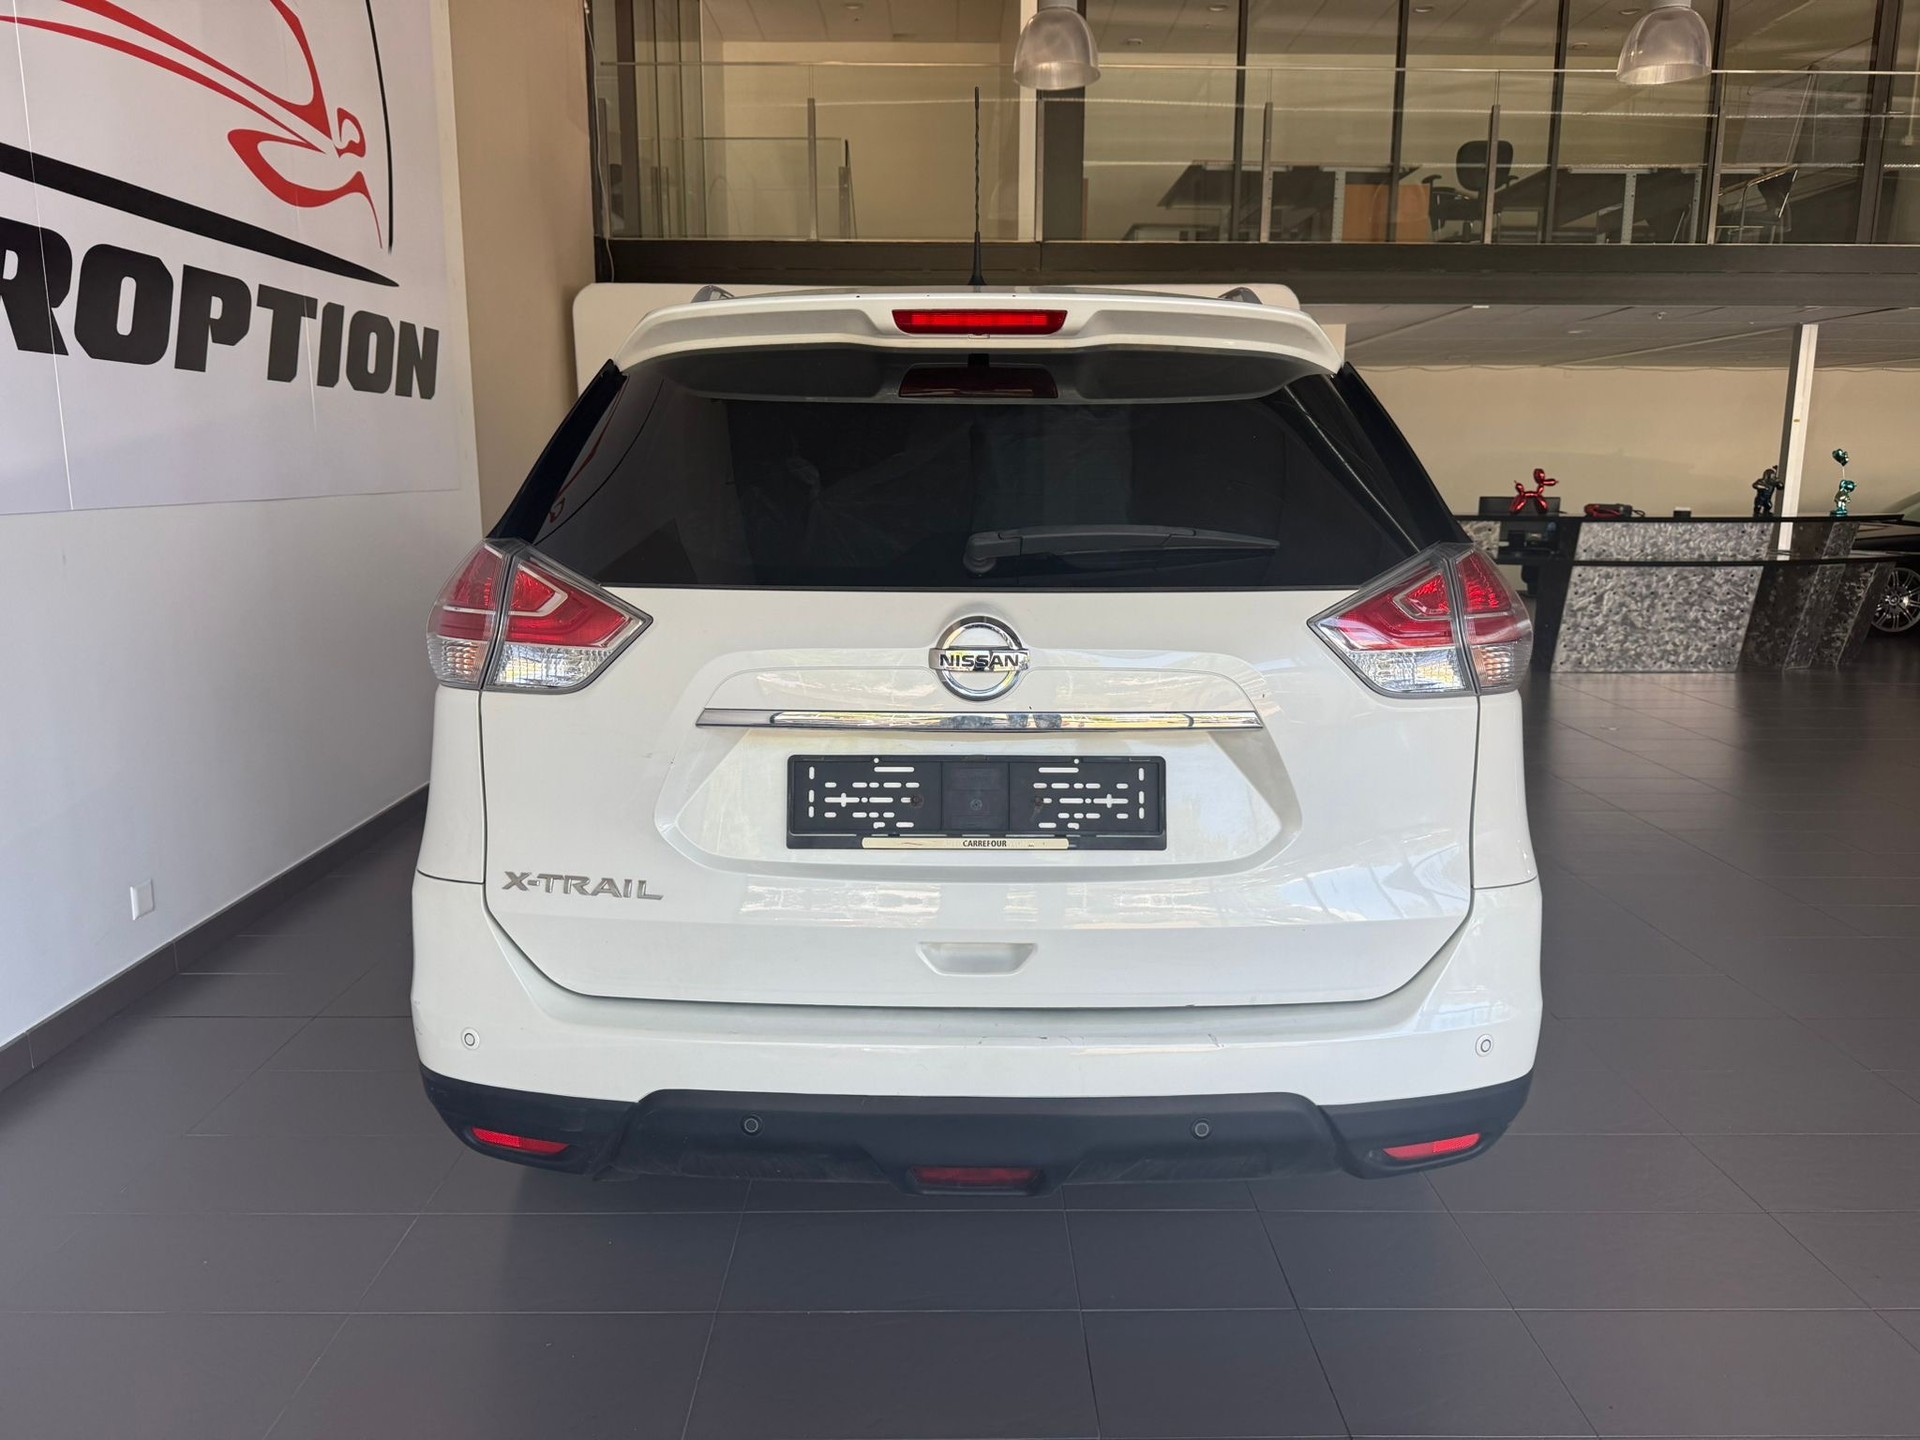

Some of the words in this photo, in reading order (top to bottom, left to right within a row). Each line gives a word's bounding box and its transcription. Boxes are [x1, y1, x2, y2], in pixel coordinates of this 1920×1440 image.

[940, 654, 1018, 668] NISSAN
[963, 840, 1007, 848] CARREFOUR
[502, 871, 664, 900] X-TRAIL
